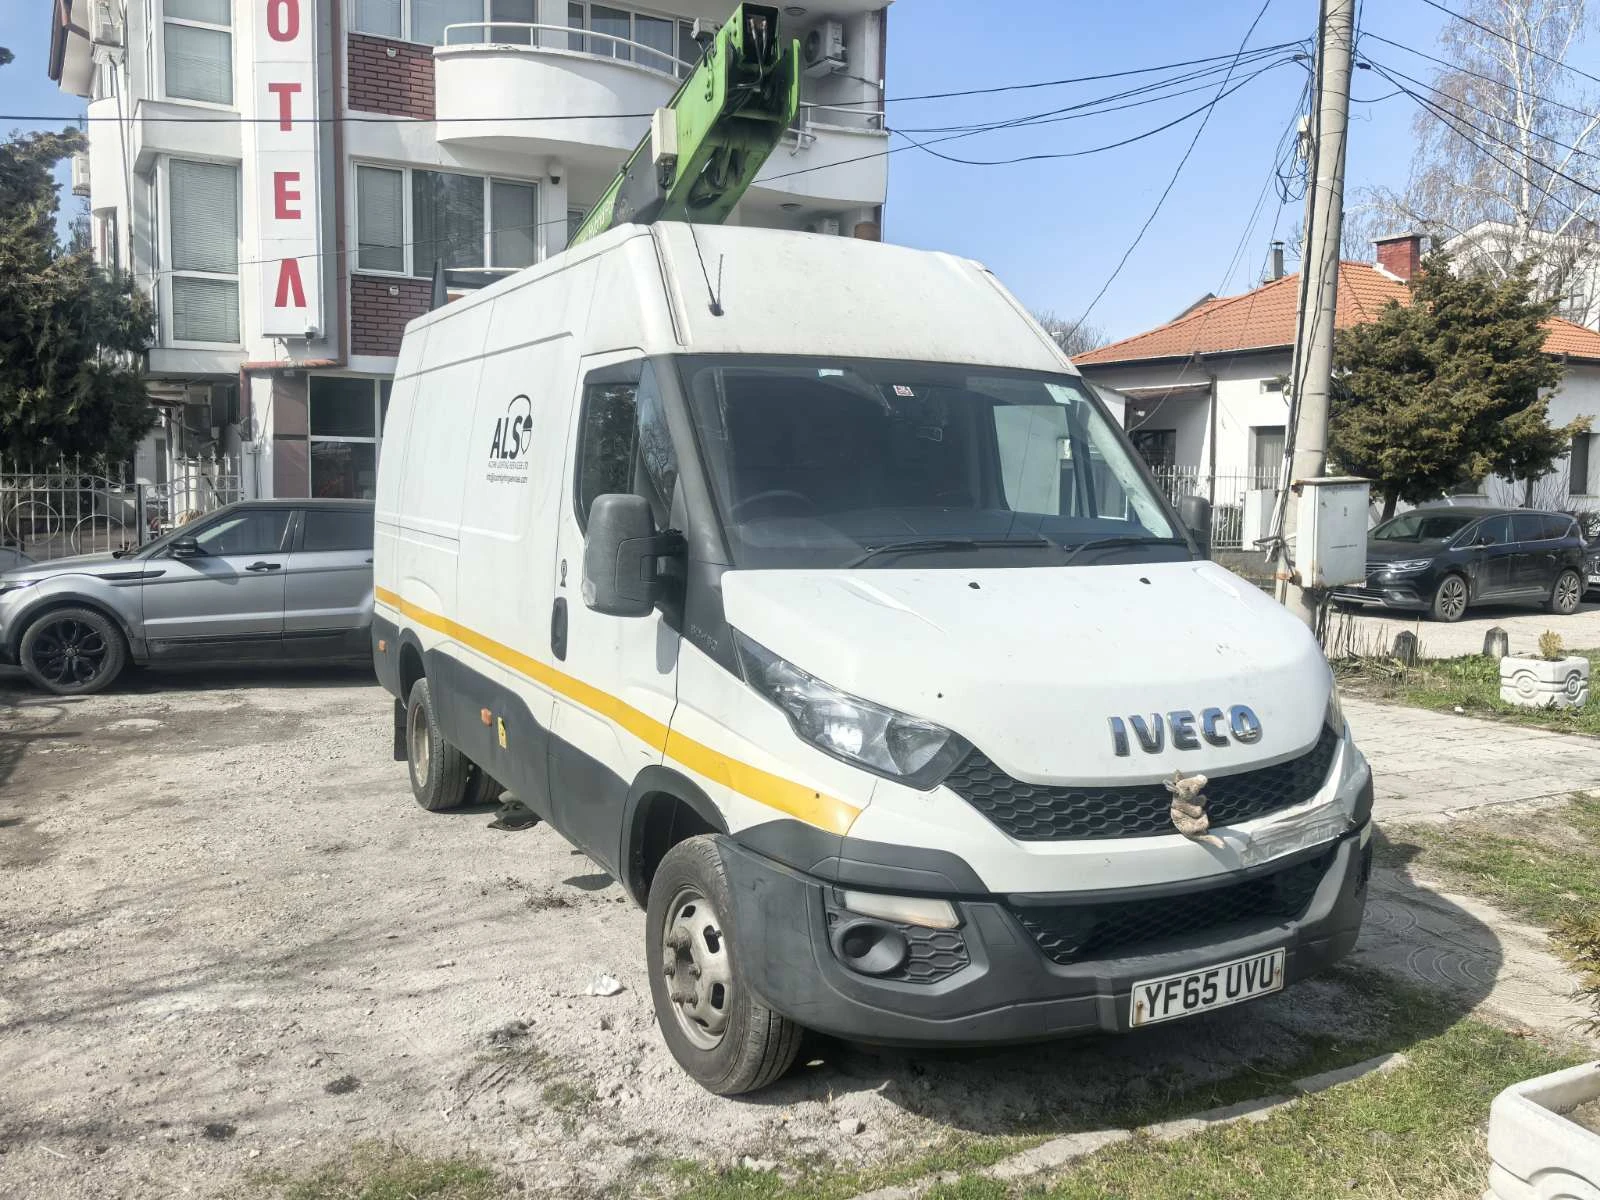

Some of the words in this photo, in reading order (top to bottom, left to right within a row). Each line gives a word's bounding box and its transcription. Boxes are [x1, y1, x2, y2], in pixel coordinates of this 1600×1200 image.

[489, 415, 523, 460] ALS
[1107, 704, 1263, 757] IVECO
[1145, 970, 1219, 1018] YF65
[1225, 955, 1275, 999] UVU
